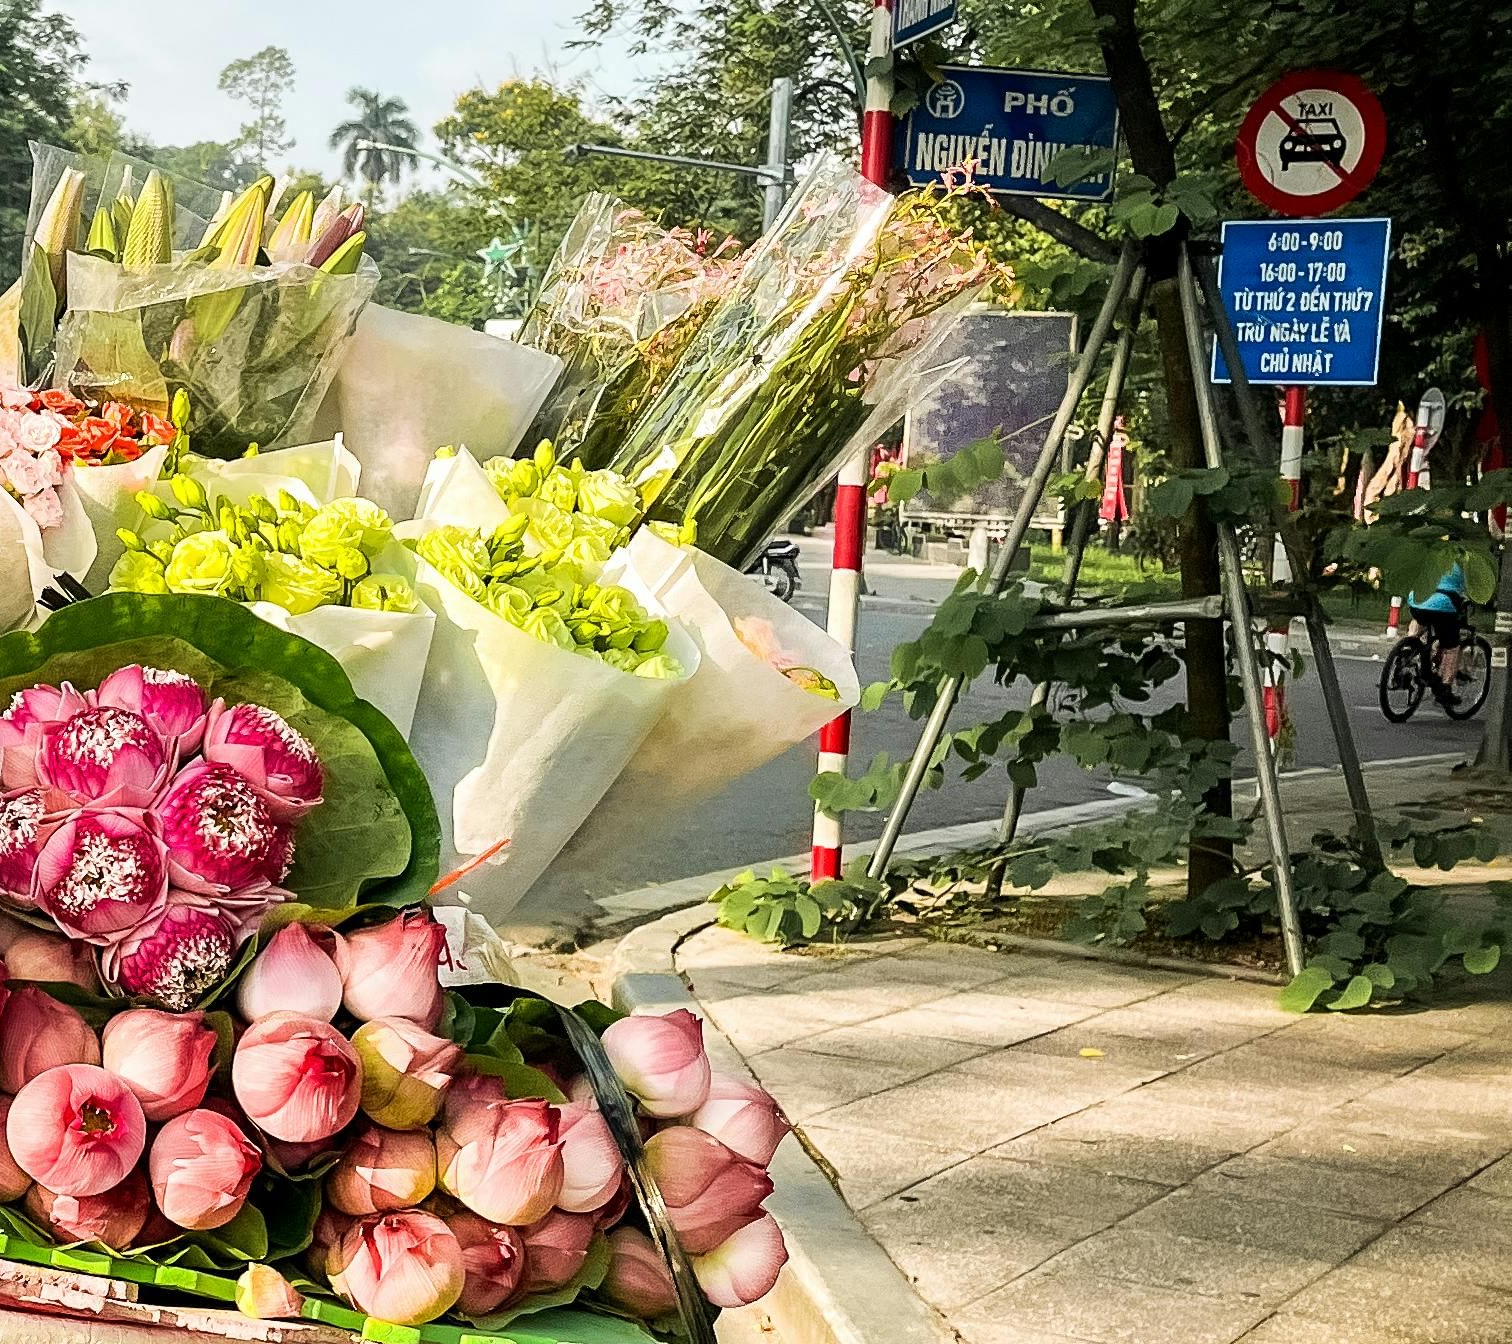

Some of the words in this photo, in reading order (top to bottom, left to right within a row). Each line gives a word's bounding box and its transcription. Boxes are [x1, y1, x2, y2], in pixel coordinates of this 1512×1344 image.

[1004, 87, 1076, 117] PHỐ
[1298, 102, 1333, 118] TAXI
[1234, 288, 1255, 311] TỪ
[1300, 285, 1330, 312] ĐẾN
[1269, 318, 1309, 343] NGÀY
[1311, 316, 1330, 343] LỄ
[1334, 318, 1351, 343] VÀ
[1260, 347, 1289, 373] CHỦ
[1292, 349, 1334, 377] NHẬT
